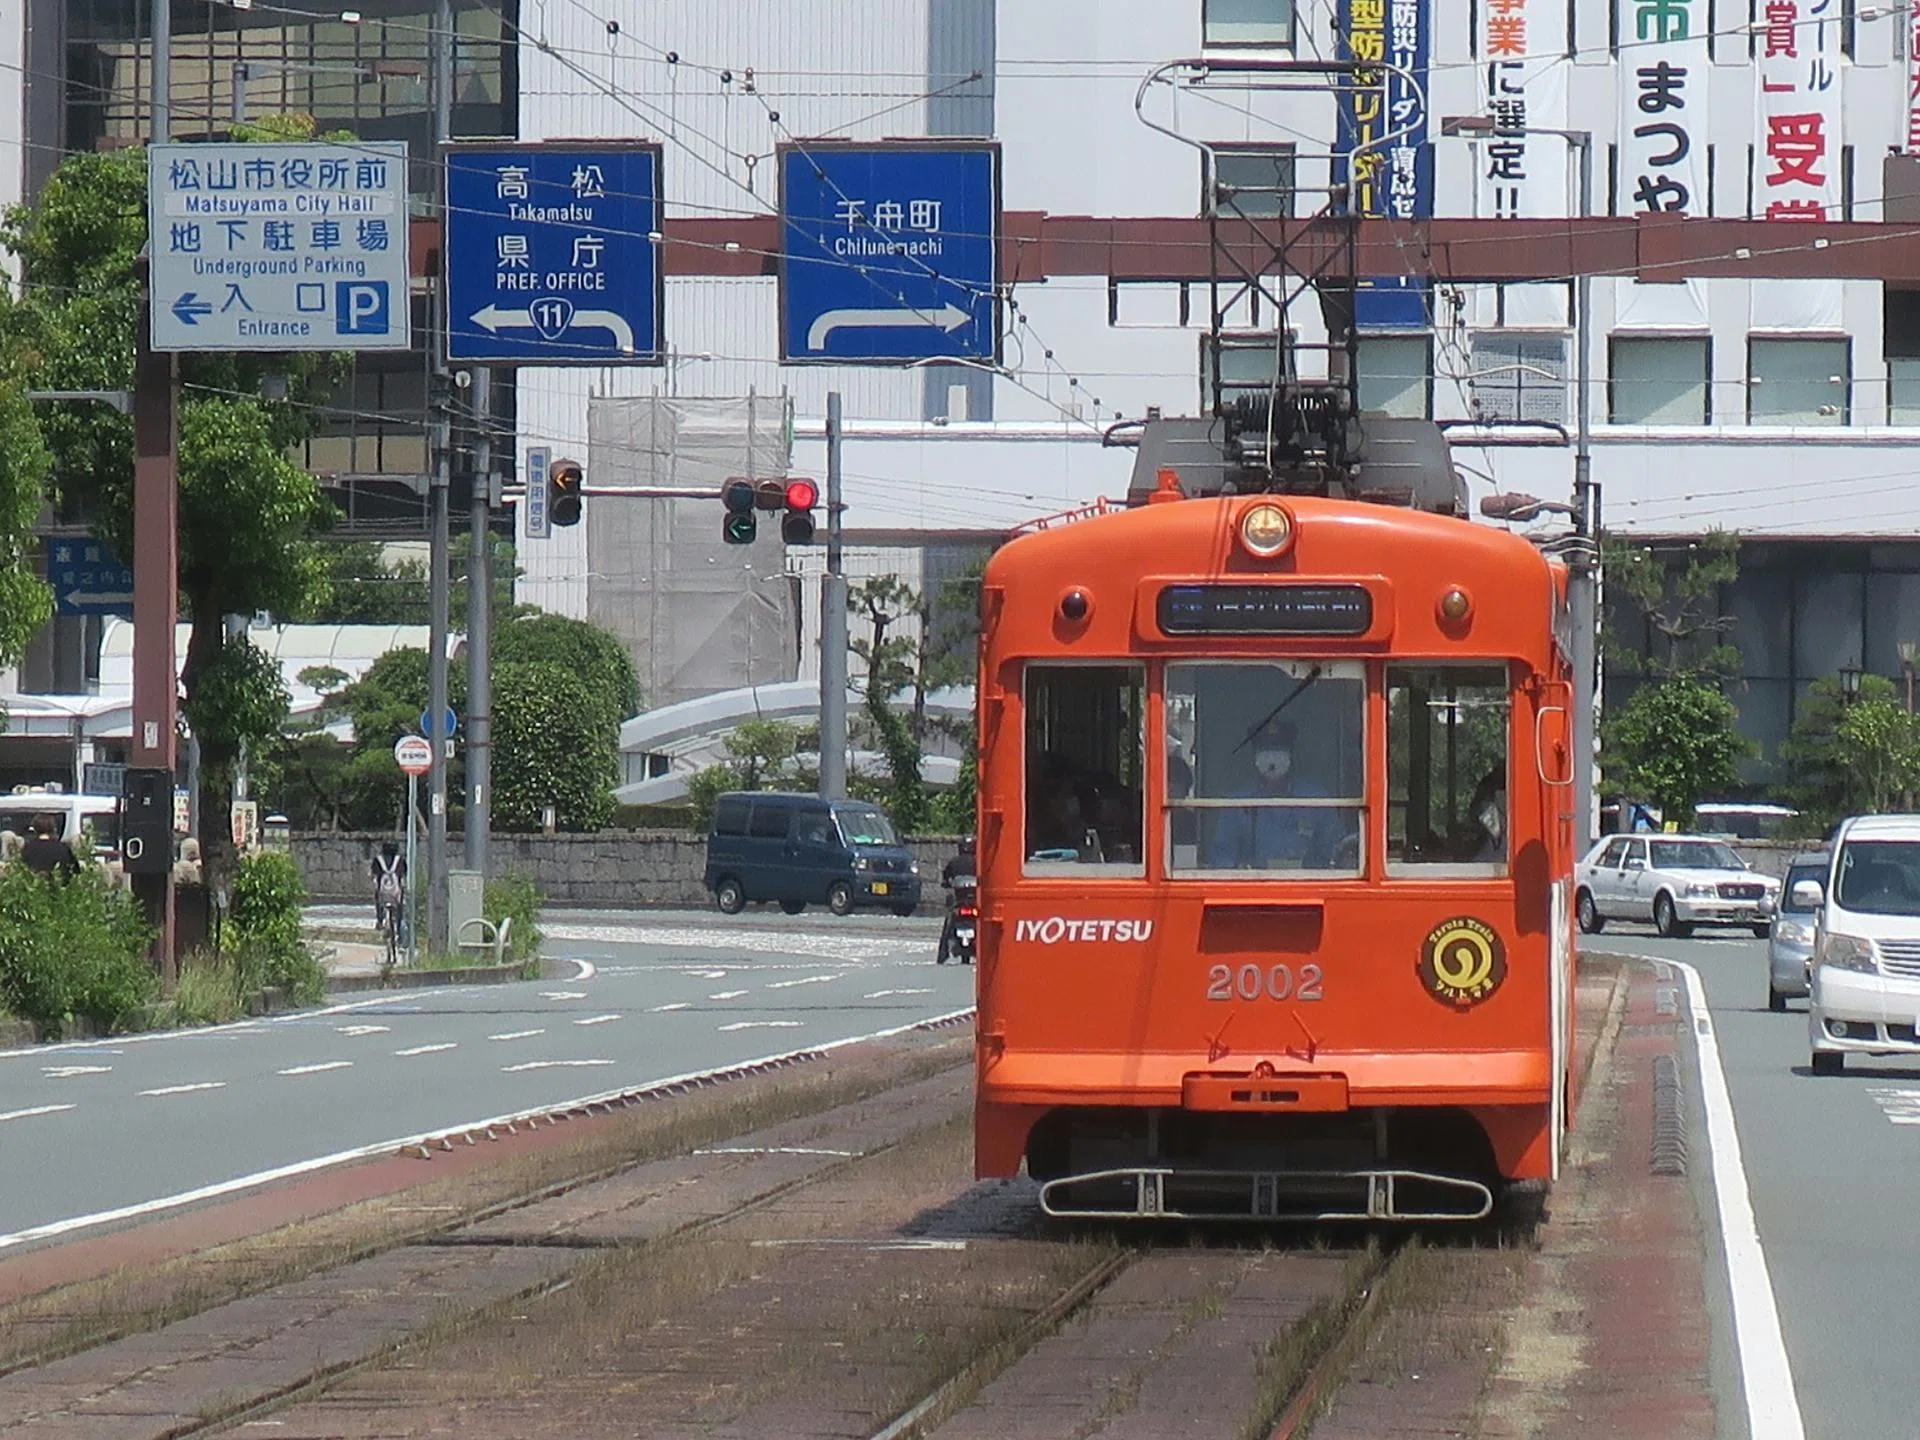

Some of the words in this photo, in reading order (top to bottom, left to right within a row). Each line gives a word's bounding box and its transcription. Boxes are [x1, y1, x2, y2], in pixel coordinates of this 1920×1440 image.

[169, 157, 388, 190] 松山市役所前
[496, 164, 605, 199] 高松
[185, 196, 288, 215] Matsuyama
[295, 195, 331, 215] City
[337, 194, 374, 212] Hall
[508, 203, 593, 222] Takamatsu
[834, 199, 942, 233] 千舟町
[169, 218, 389, 251] 地下駐車場
[496, 234, 605, 269] 県庁
[193, 257, 298, 278] Underground
[303, 257, 366, 277] Parking
[496, 272, 541, 290] PREF.
[546, 272, 606, 290] OFFICE
[220, 283, 326, 312] 入口
[348, 285, 381, 330] P
[238, 319, 310, 336] Entrance
[537, 303, 563, 328] 11
[1015, 916, 1153, 944] IYOTETSU
[1207, 963, 1324, 1001] 2002
